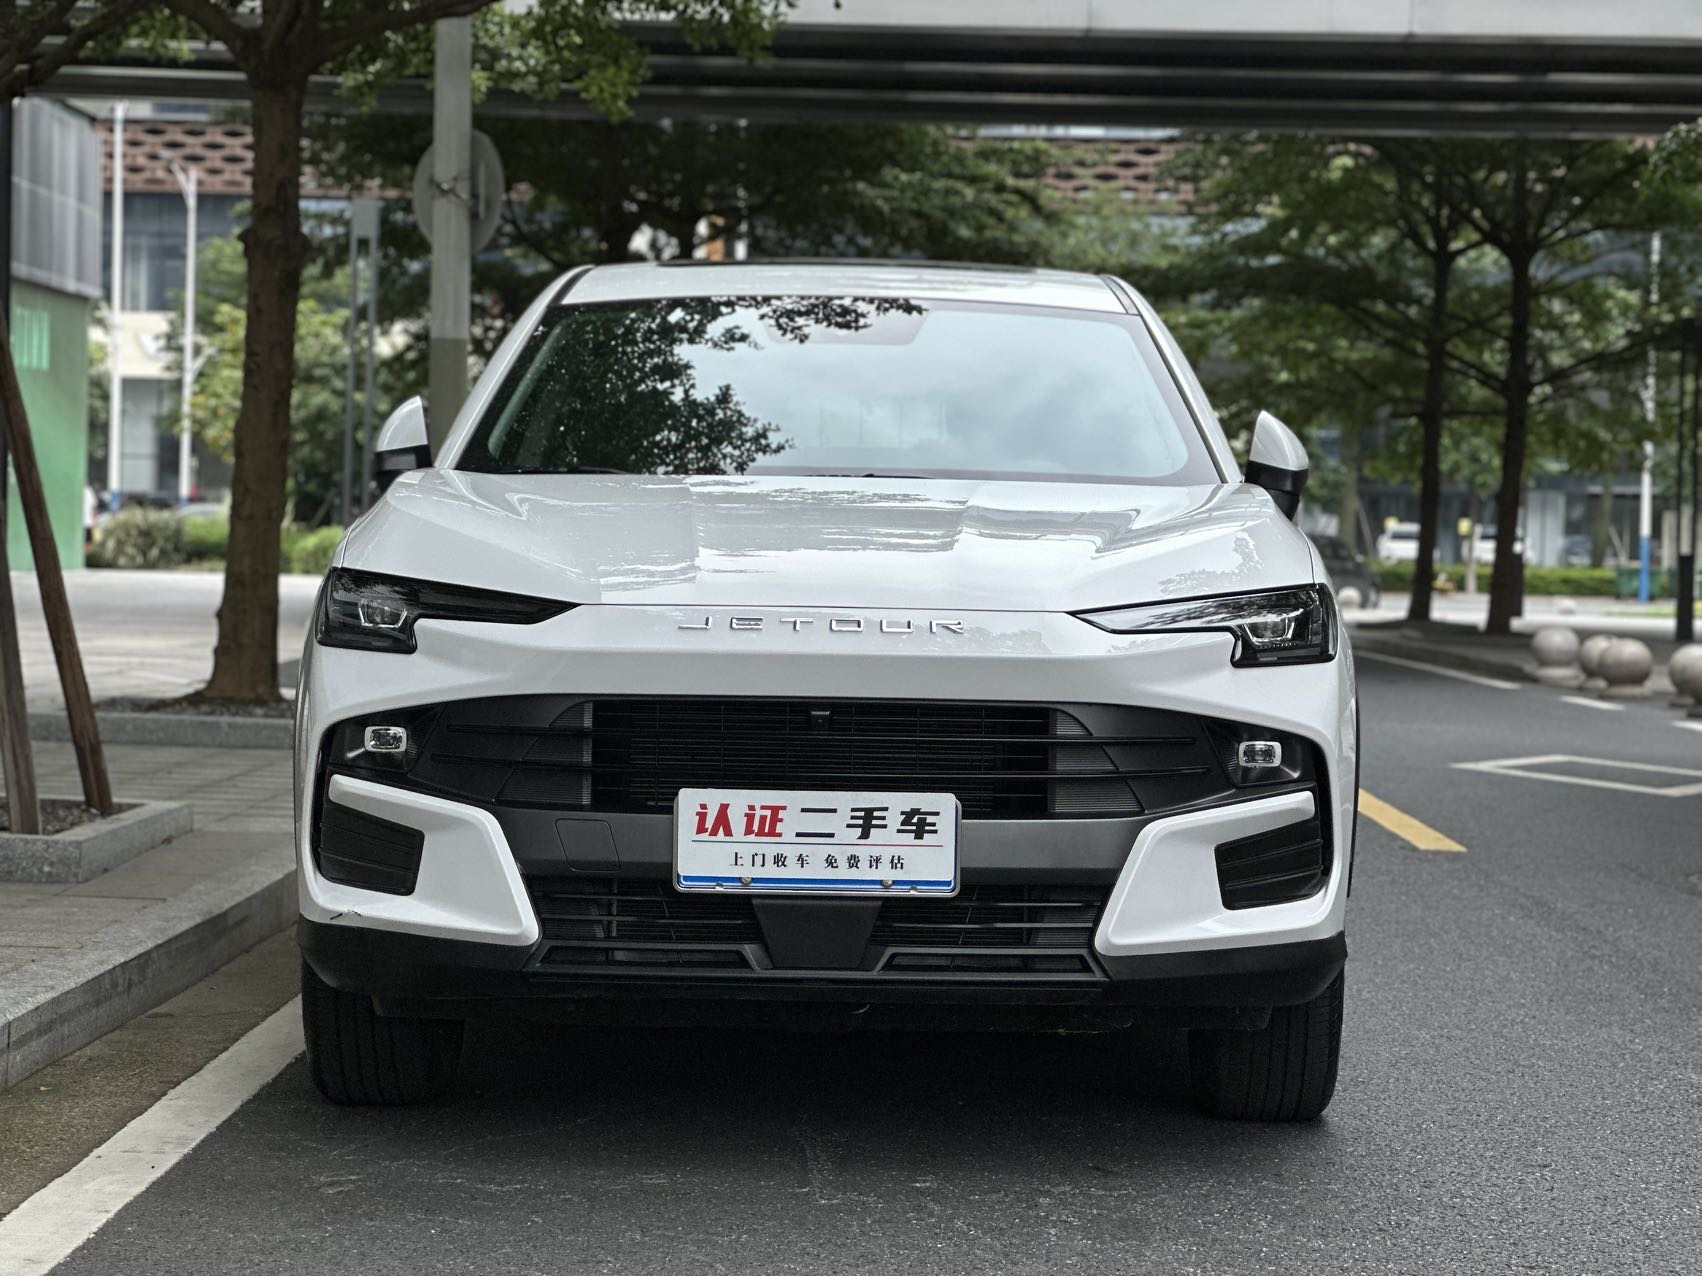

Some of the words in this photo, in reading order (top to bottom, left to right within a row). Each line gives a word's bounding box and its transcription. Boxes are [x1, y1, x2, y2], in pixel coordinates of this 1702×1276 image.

[678, 616, 965, 633] JETOUR
[695, 803, 941, 840] 认证二手车
[729, 851, 810, 869] 上门收车
[824, 853, 905, 870] 免费评估
